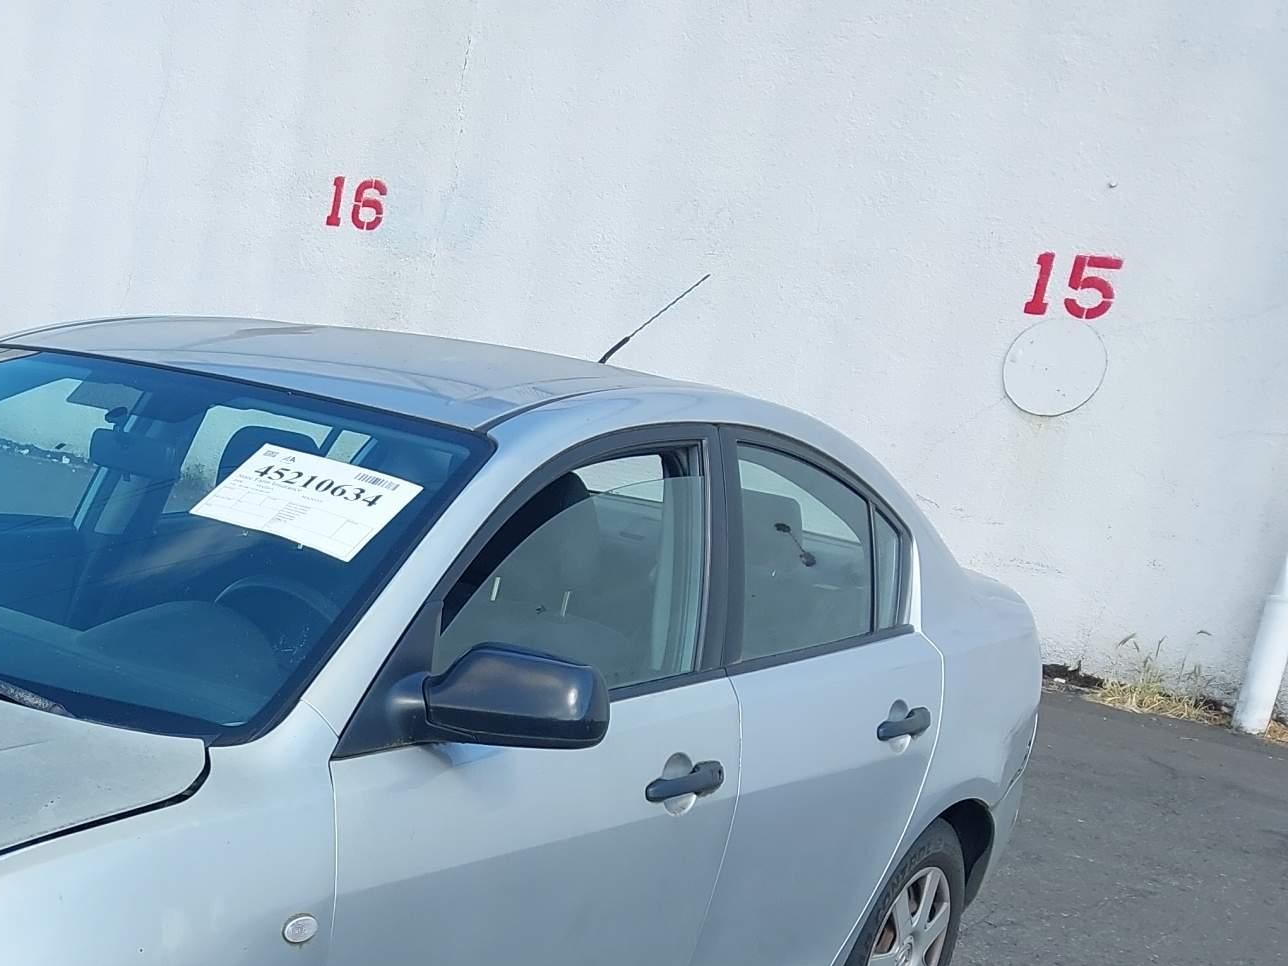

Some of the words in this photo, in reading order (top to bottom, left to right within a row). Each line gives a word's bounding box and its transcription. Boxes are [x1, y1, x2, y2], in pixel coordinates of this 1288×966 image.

[325, 175, 388, 231] 16
[1023, 251, 1124, 320] 15
[253, 464, 384, 508] 45210634
